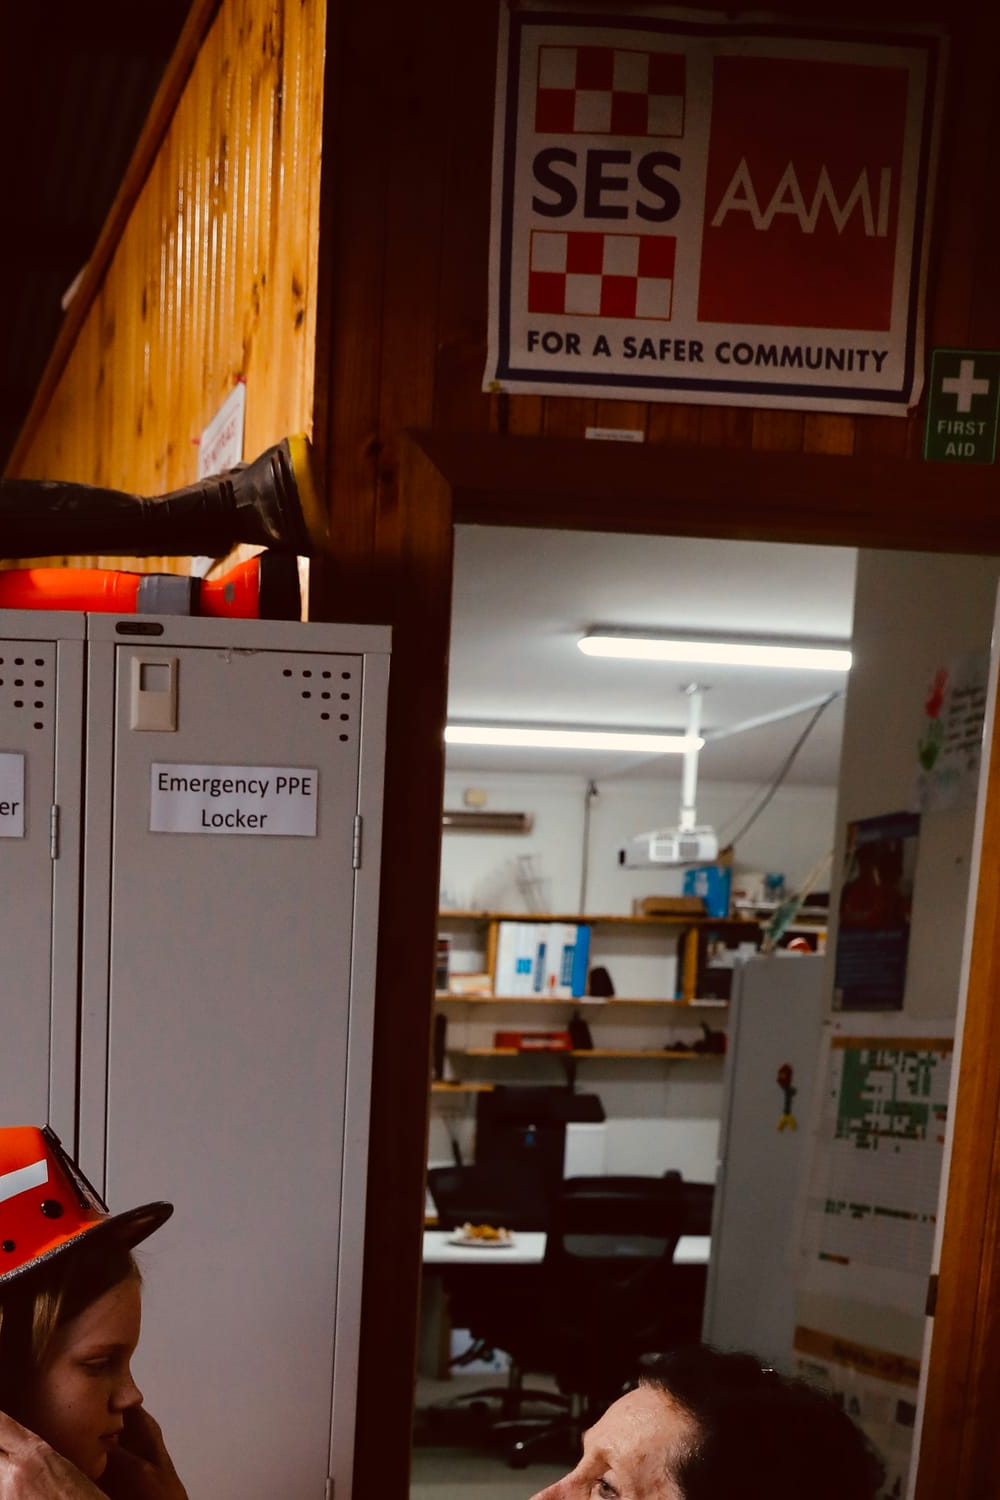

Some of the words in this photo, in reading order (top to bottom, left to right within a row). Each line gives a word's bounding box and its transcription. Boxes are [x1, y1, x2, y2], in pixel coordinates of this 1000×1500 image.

[531, 147, 682, 222] SES
[711, 156, 892, 238] AAMI
[527, 330, 581, 356] FOR
[592, 335, 612, 357] A
[623, 336, 704, 363] SAFER
[715, 341, 889, 373] COMMUNITY
[937, 420, 987, 436] FIRST
[945, 441, 976, 457] AID
[158, 773, 269, 798] Emergency
[276, 776, 312, 796] PPE
[201, 808, 268, 828] Locker
